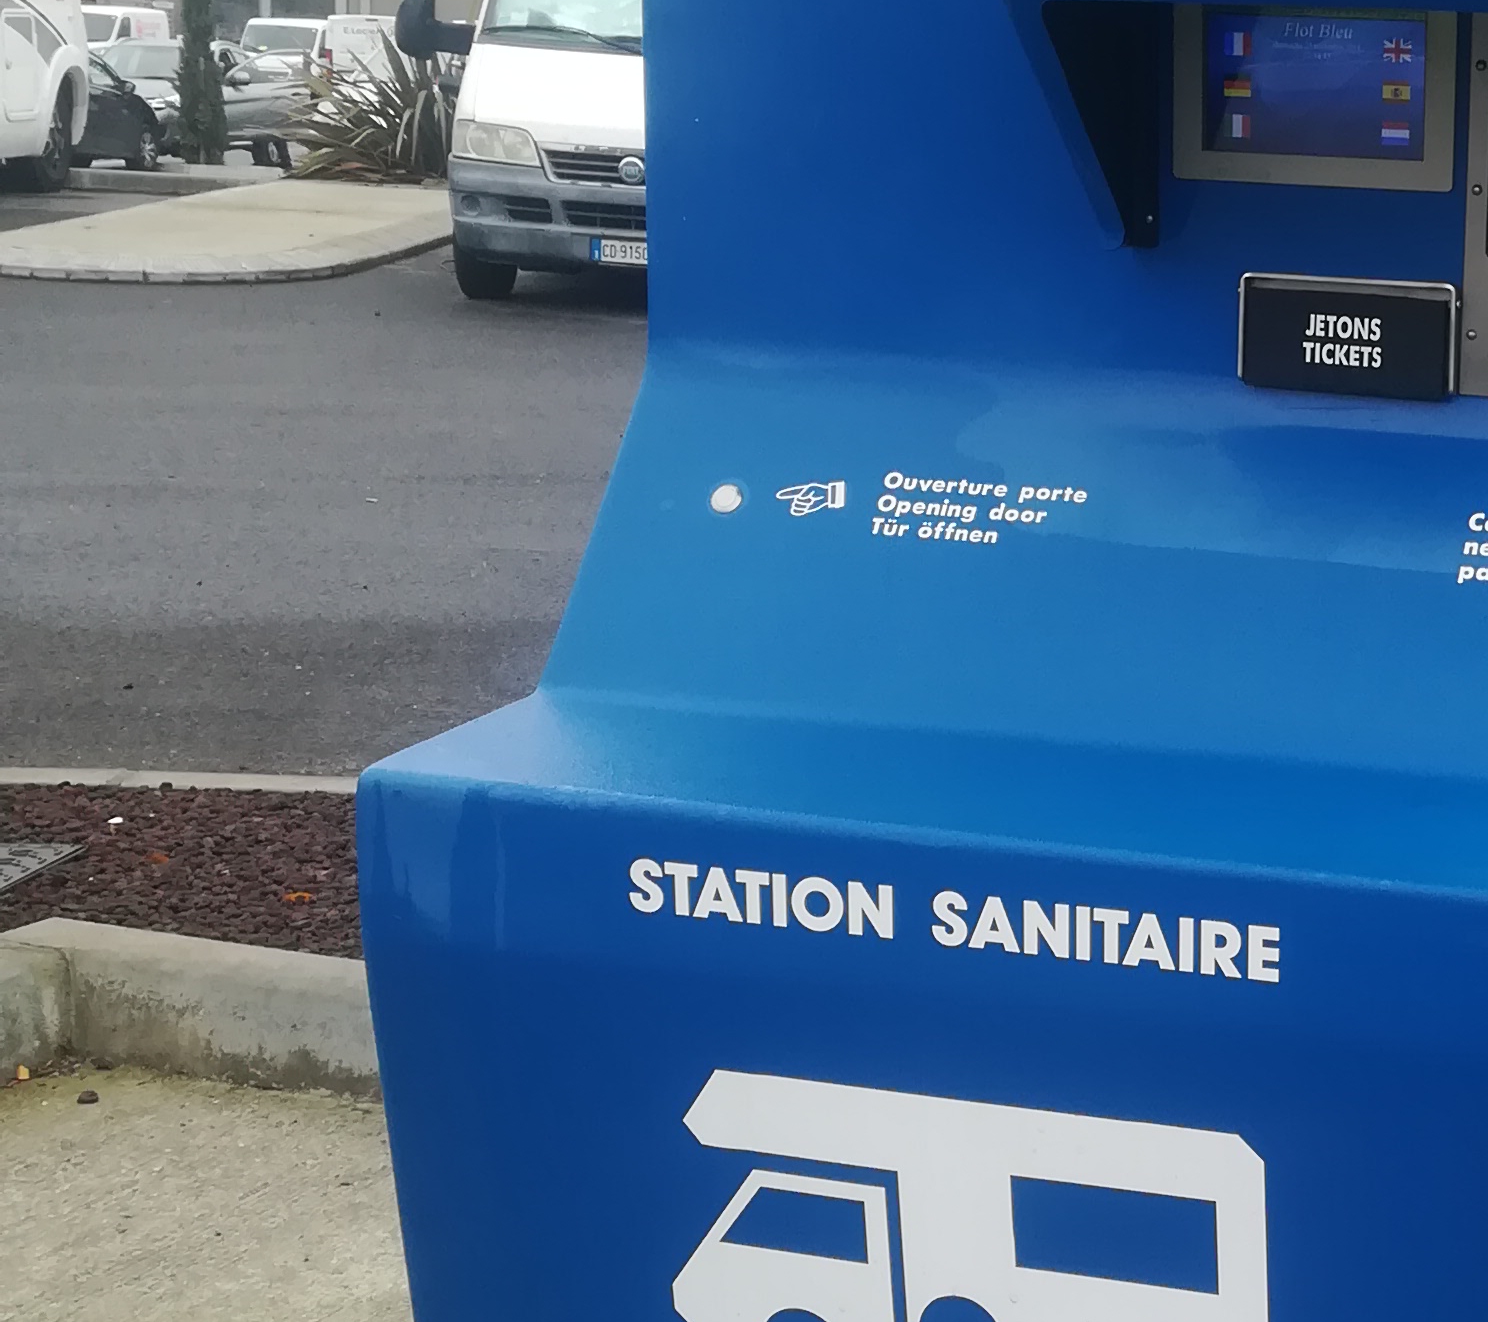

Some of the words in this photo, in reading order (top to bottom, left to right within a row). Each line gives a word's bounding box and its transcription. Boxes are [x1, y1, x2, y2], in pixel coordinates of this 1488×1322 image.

[1283, 22, 1314, 38] Flot
[1318, 23, 1354, 39] Bleu
[1305, 313, 1382, 341] JETONS
[1302, 341, 1382, 368] TICKETS
[884, 471, 1008, 497] Ouverture
[1018, 485, 1088, 504] porte
[876, 494, 977, 523] Opening
[989, 502, 1048, 524] door
[871, 517, 909, 538] Tür
[918, 520, 998, 544] öffnen
[628, 857, 895, 940] STATION
[930, 889, 1281, 983] SANITAIRE
